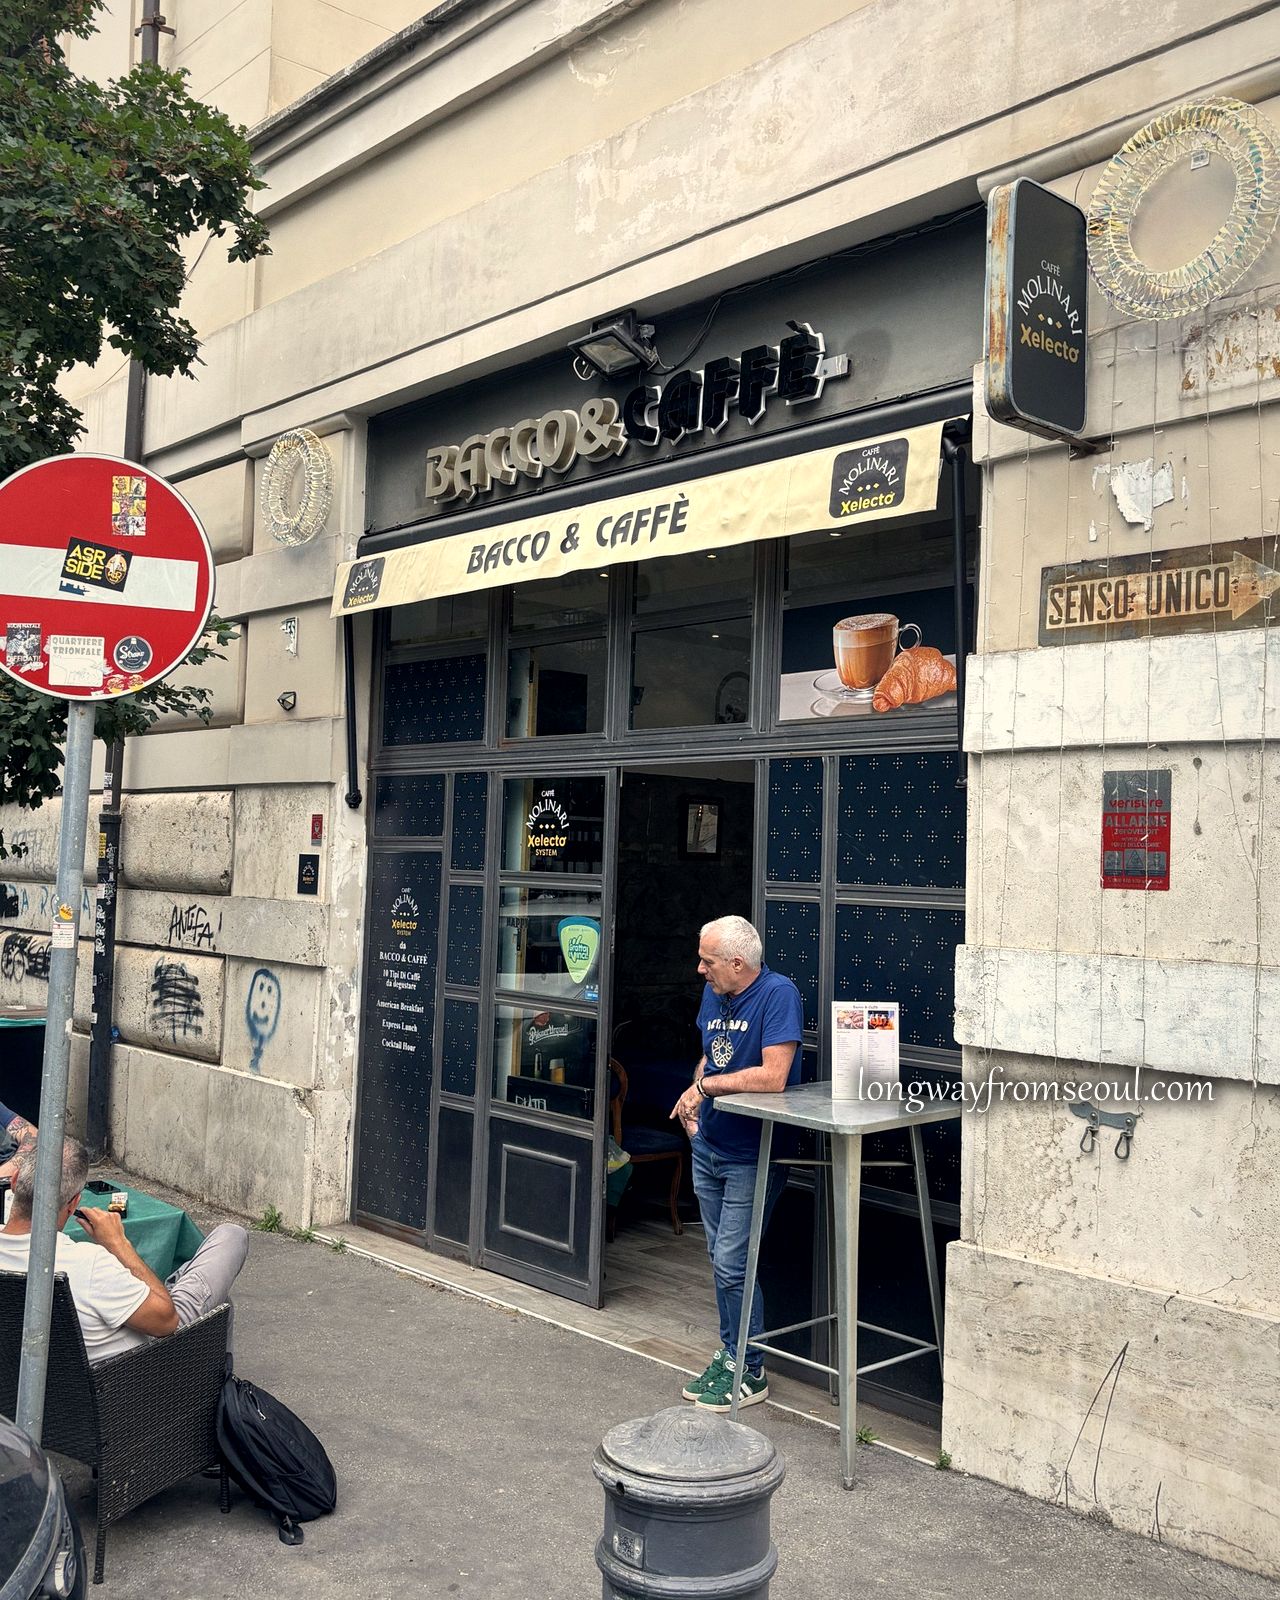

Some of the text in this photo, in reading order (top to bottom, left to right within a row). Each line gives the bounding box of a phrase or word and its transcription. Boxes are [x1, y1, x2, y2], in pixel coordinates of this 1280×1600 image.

[1041, 259, 1061, 277] CAFFÈ
[1017, 275, 1083, 335] MOLINARI
[861, 446, 881, 457] CAFFÈ
[838, 457, 900, 495] MOLINARI
[467, 493, 691, 574] BACCO & CAFFÈ
[65, 559, 104, 580] SIDE
[349, 568, 378, 594] MOLINARI
[1048, 566, 1230, 625] SENSO UNICO
[52, 636, 103, 646] QUARTIERE
[53, 646, 102, 656] TRIONFALE
[1109, 799, 1163, 808] verisure
[525, 798, 570, 830] MOLINARI
[1105, 815, 1167, 827] ALLARME
[391, 894, 419, 917] MOLINARI
[379, 951, 428, 965] BACCO & CAFFÈ
[389, 969, 399, 979] Tipi
[400, 971, 406, 979] Di
[406, 971, 421, 982] Caffè
[386, 979, 417, 990] da degustare
[376, 999, 424, 1013] American Breakfast
[382, 1019, 418, 1032] Express Lunch
[381, 1038, 417, 1052] Cocktail Hour
